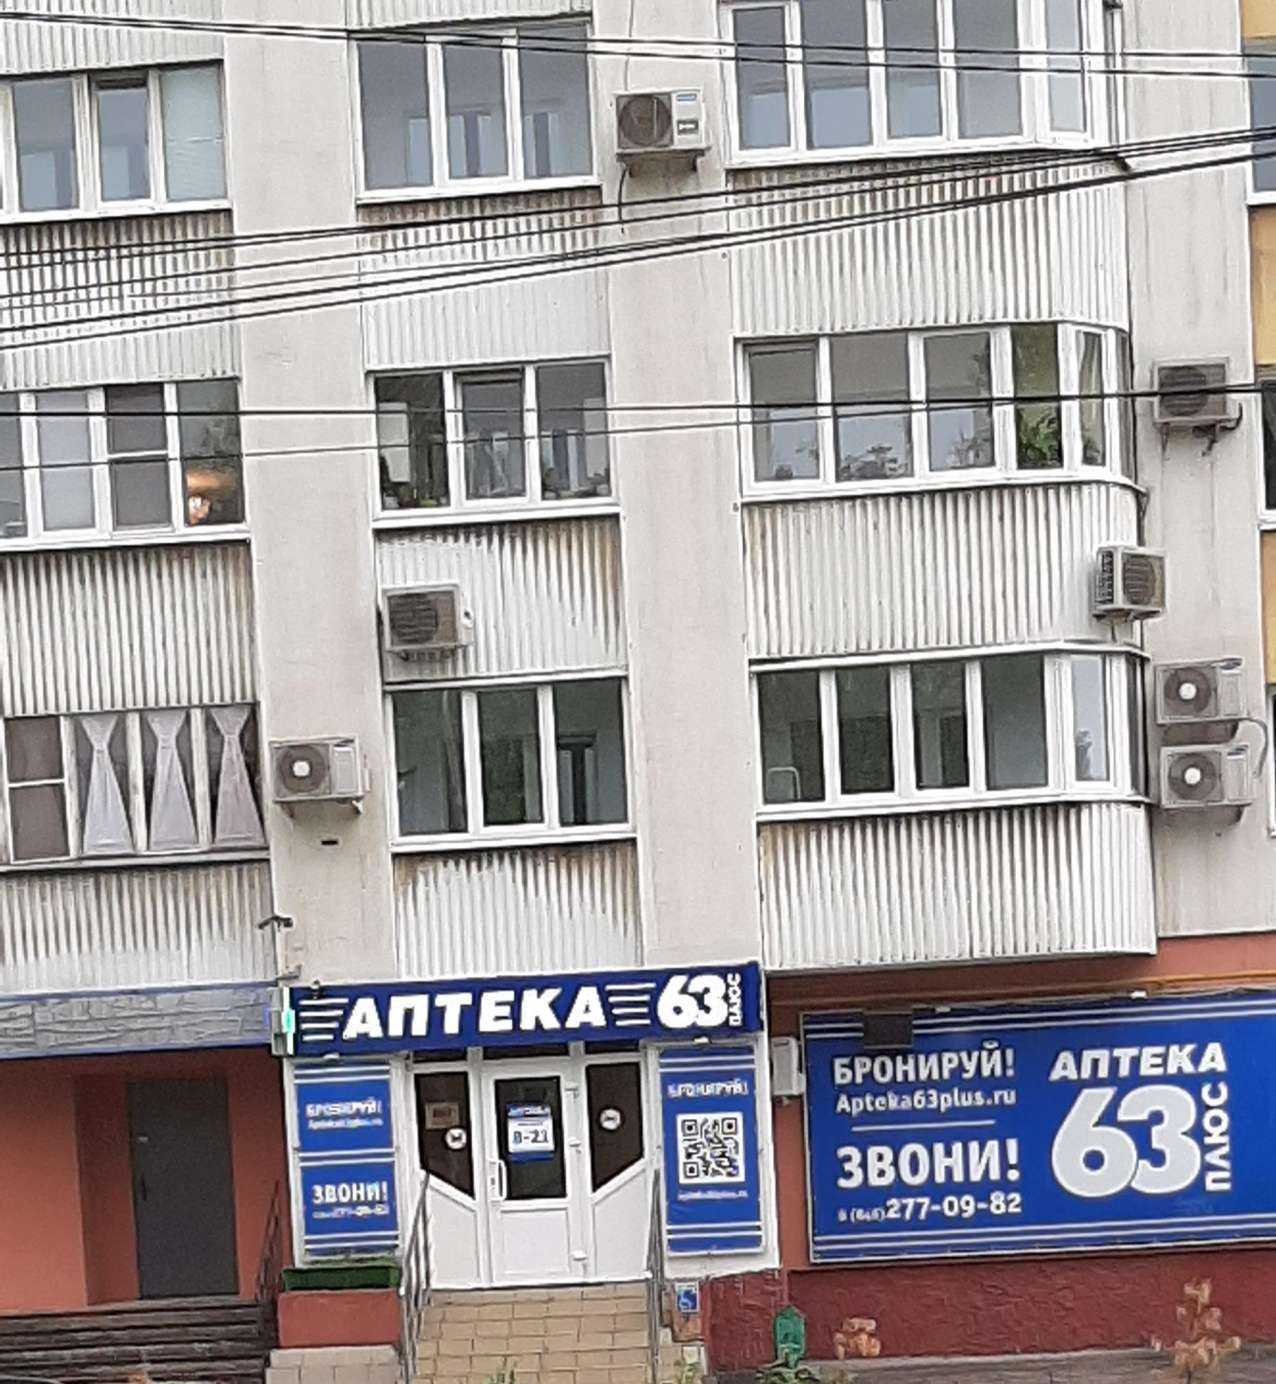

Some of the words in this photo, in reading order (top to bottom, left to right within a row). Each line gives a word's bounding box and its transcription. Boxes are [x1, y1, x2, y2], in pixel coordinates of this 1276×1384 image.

[342, 986, 606, 1039] АПТЕКА
[657, 974, 728, 1028] 63
[727, 973, 742, 1027] ПЛЮС
[833, 1040, 1015, 1086] БРОНИРУЙ!
[1048, 1042, 1228, 1081] АПТЕКА
[836, 1087, 1017, 1117] Apteka63plus.ru
[1051, 1084, 1201, 1197] 63
[1202, 1081, 1231, 1191] ПЛЮС
[836, 1138, 1020, 1188] ЗВОНИ!
[312, 1181, 388, 1205] ЗВОНИ!
